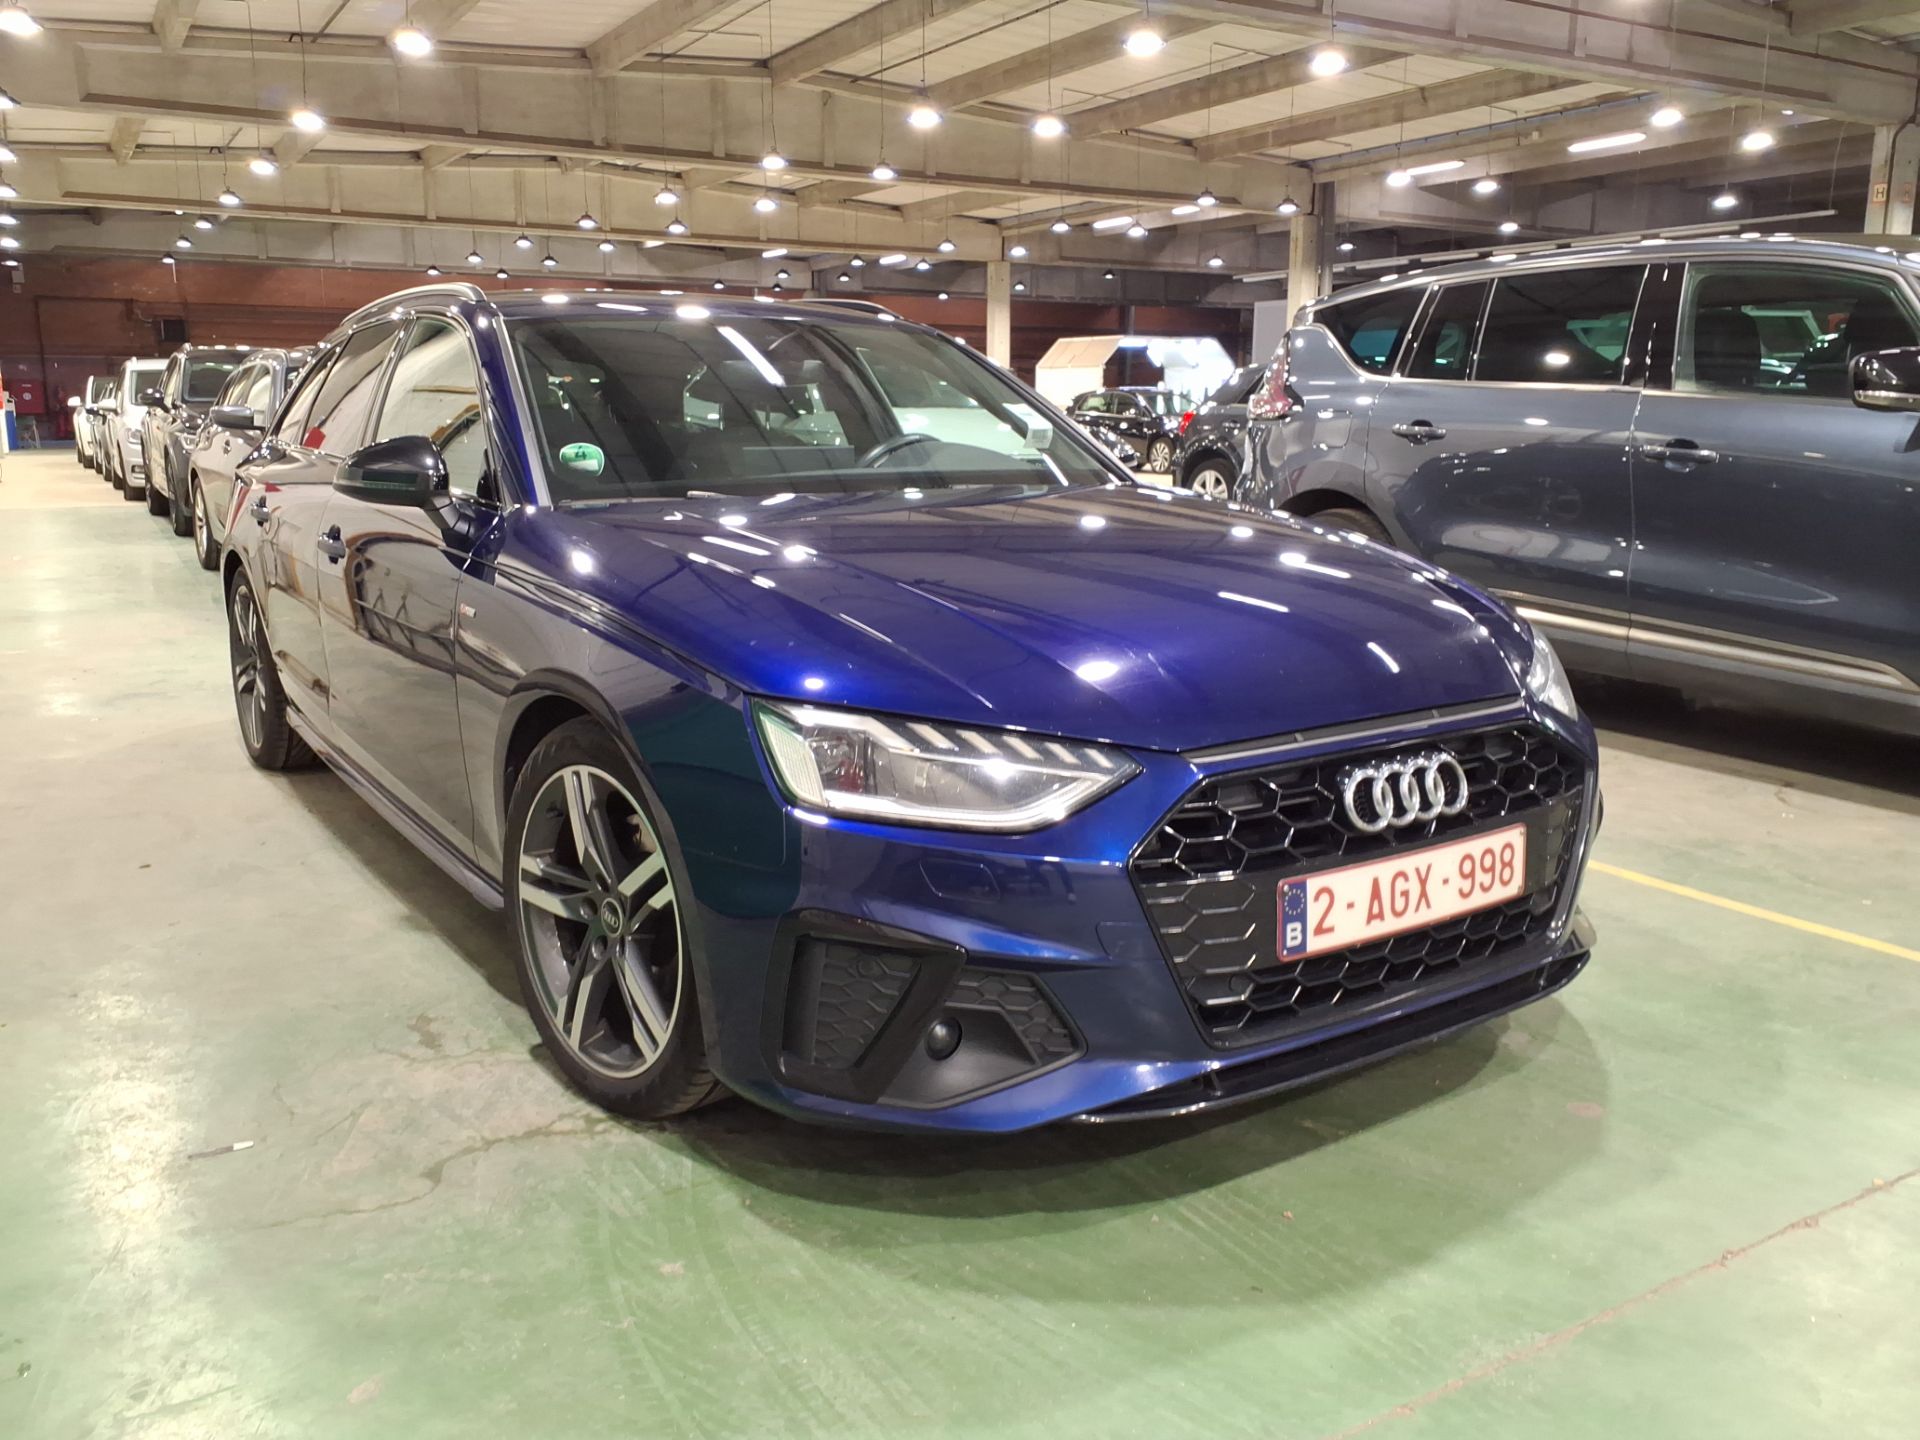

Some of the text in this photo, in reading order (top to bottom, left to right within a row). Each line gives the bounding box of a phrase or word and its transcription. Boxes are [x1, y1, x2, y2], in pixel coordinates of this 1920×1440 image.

[1876, 187, 1885, 199] H
[575, 445, 587, 460] 4
[1313, 842, 1516, 937] 2-AGX-998
[1285, 921, 1303, 948] B
